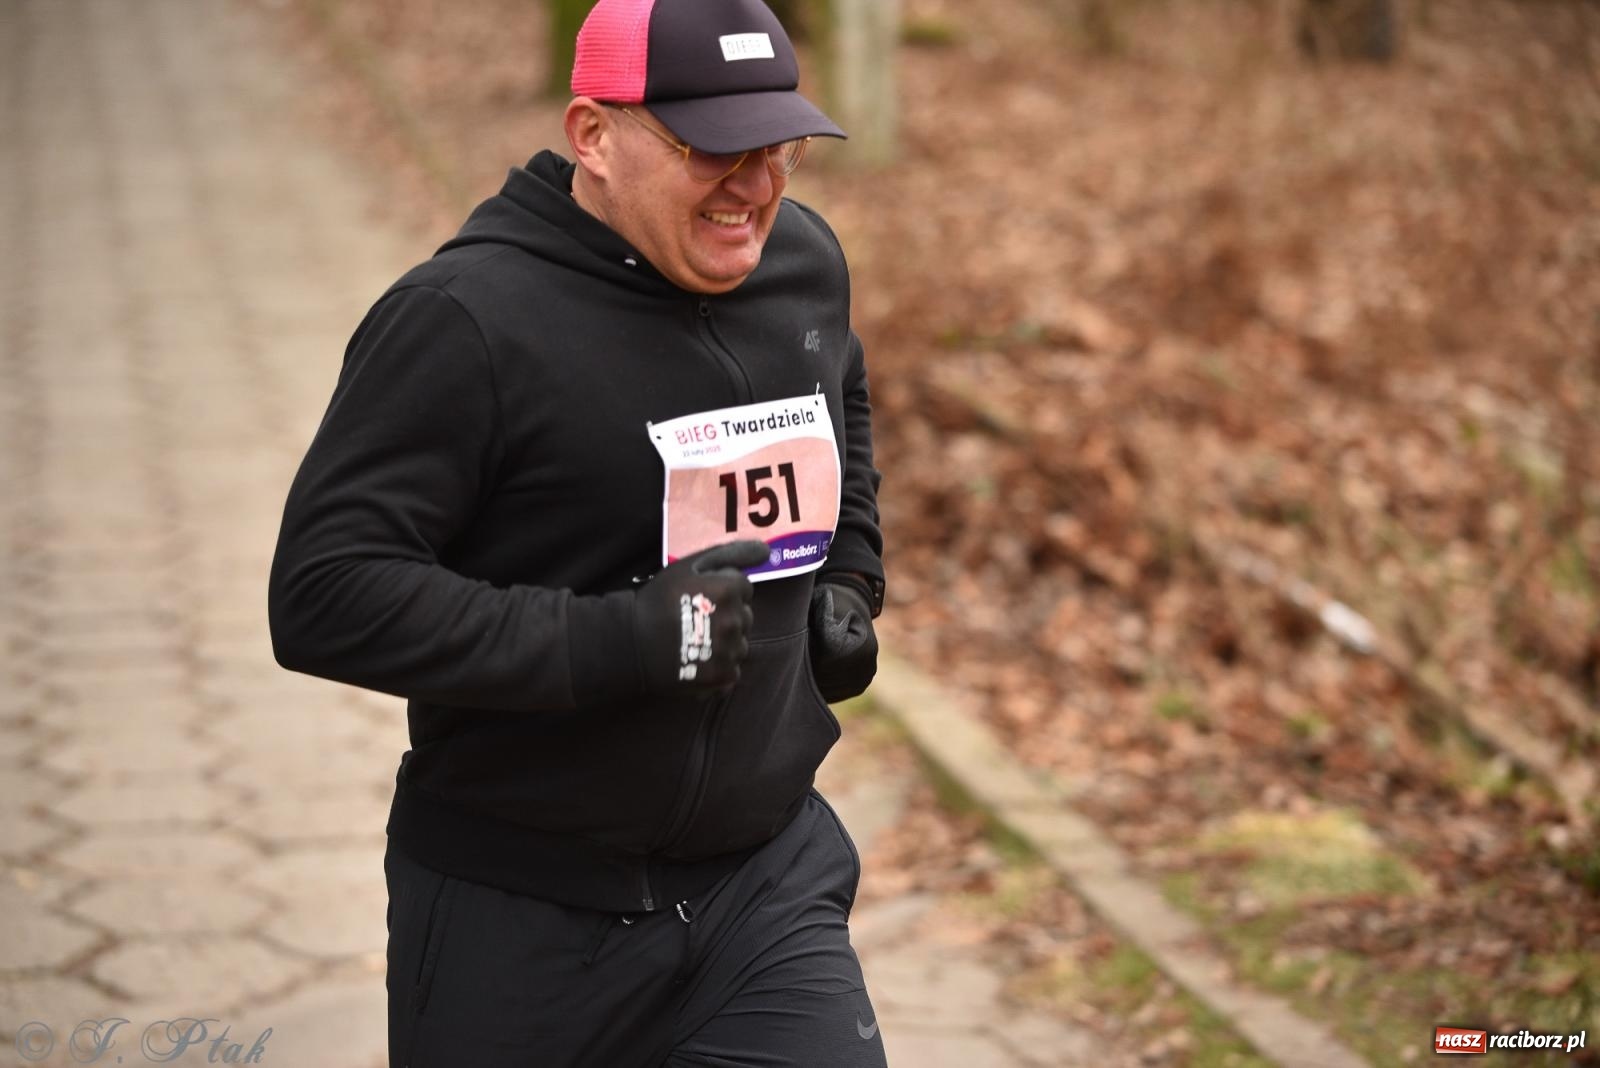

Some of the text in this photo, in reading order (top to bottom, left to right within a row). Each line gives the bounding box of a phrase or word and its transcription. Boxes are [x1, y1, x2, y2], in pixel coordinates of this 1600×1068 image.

[804, 330, 820, 352] 4F
[675, 408, 815, 445] BIEG Twardziela
[719, 462, 800, 533] 151
[782, 543, 818, 561] Racibórz
